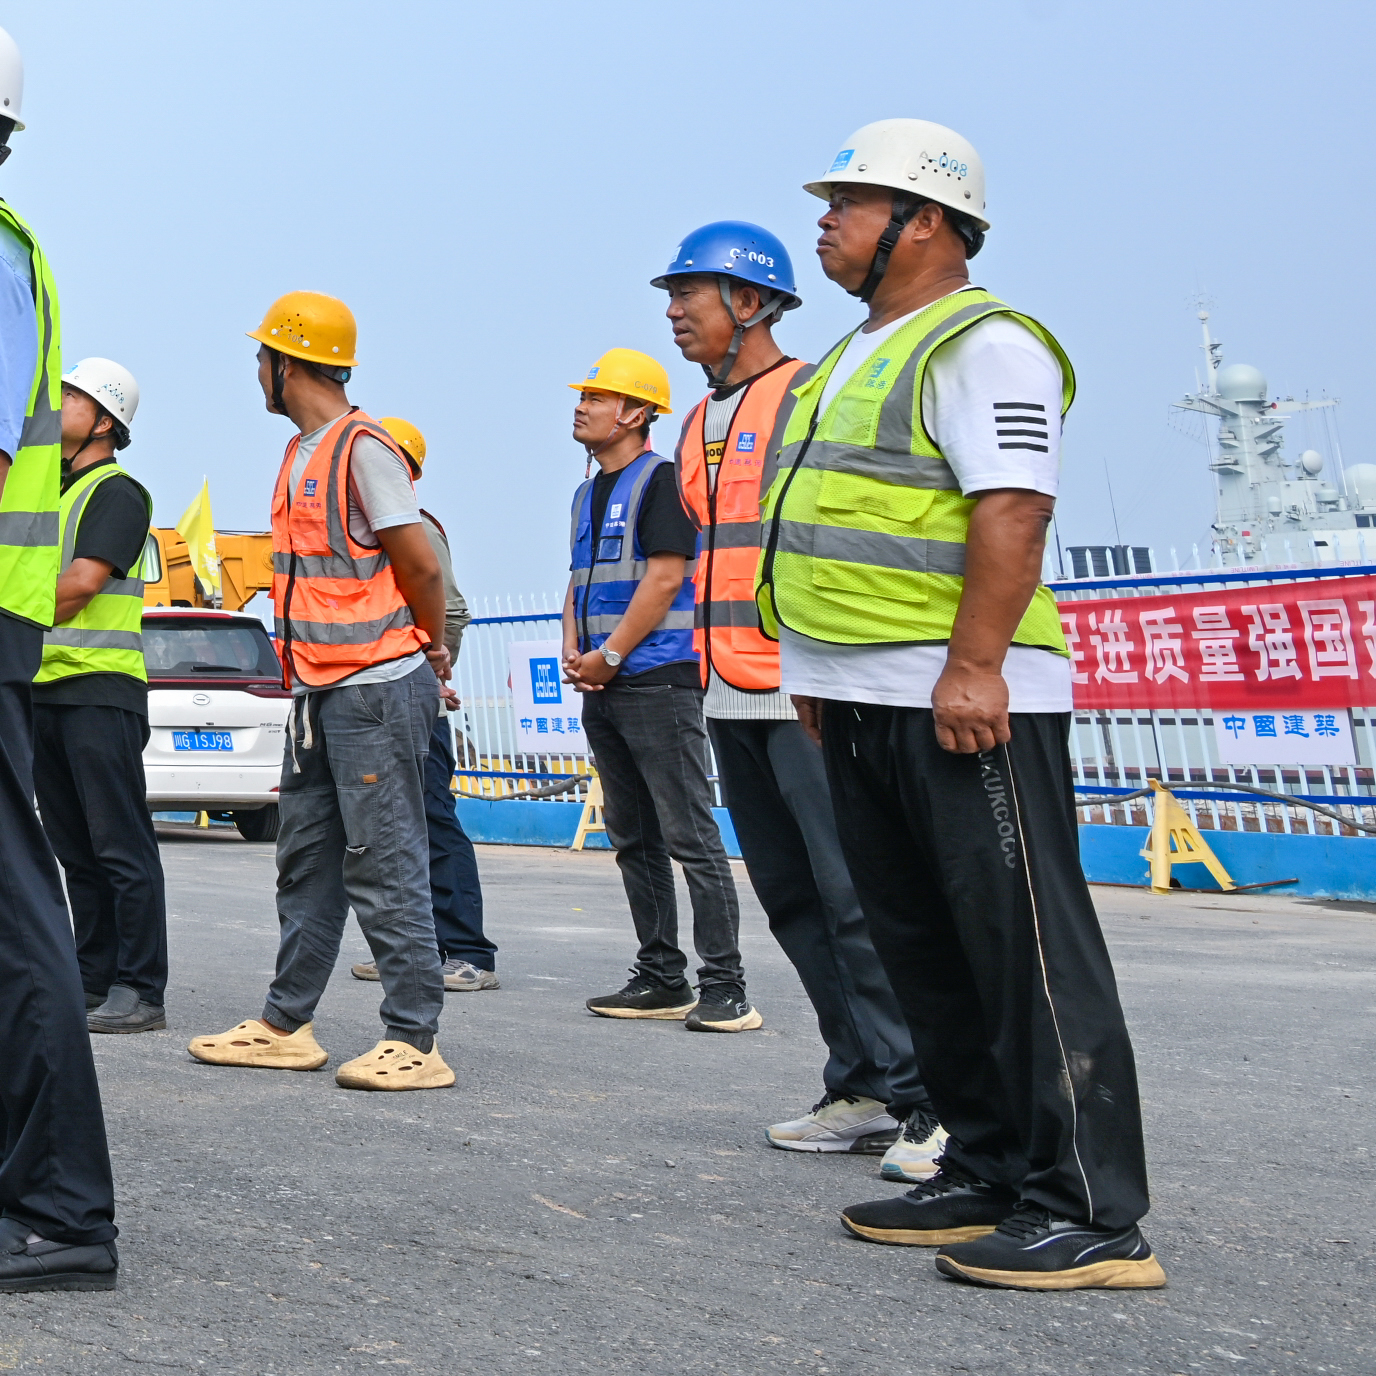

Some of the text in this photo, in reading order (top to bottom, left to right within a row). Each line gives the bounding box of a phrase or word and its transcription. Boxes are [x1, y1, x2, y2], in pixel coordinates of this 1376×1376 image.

[919, 150, 968, 177] A-008
[729, 248, 775, 268] C-003
[634, 380, 658, 394] C-079
[1059, 599, 1376, 685] 进质量强国
[520, 717, 581, 735] 中國建築
[1222, 713, 1340, 739] 中國建築
